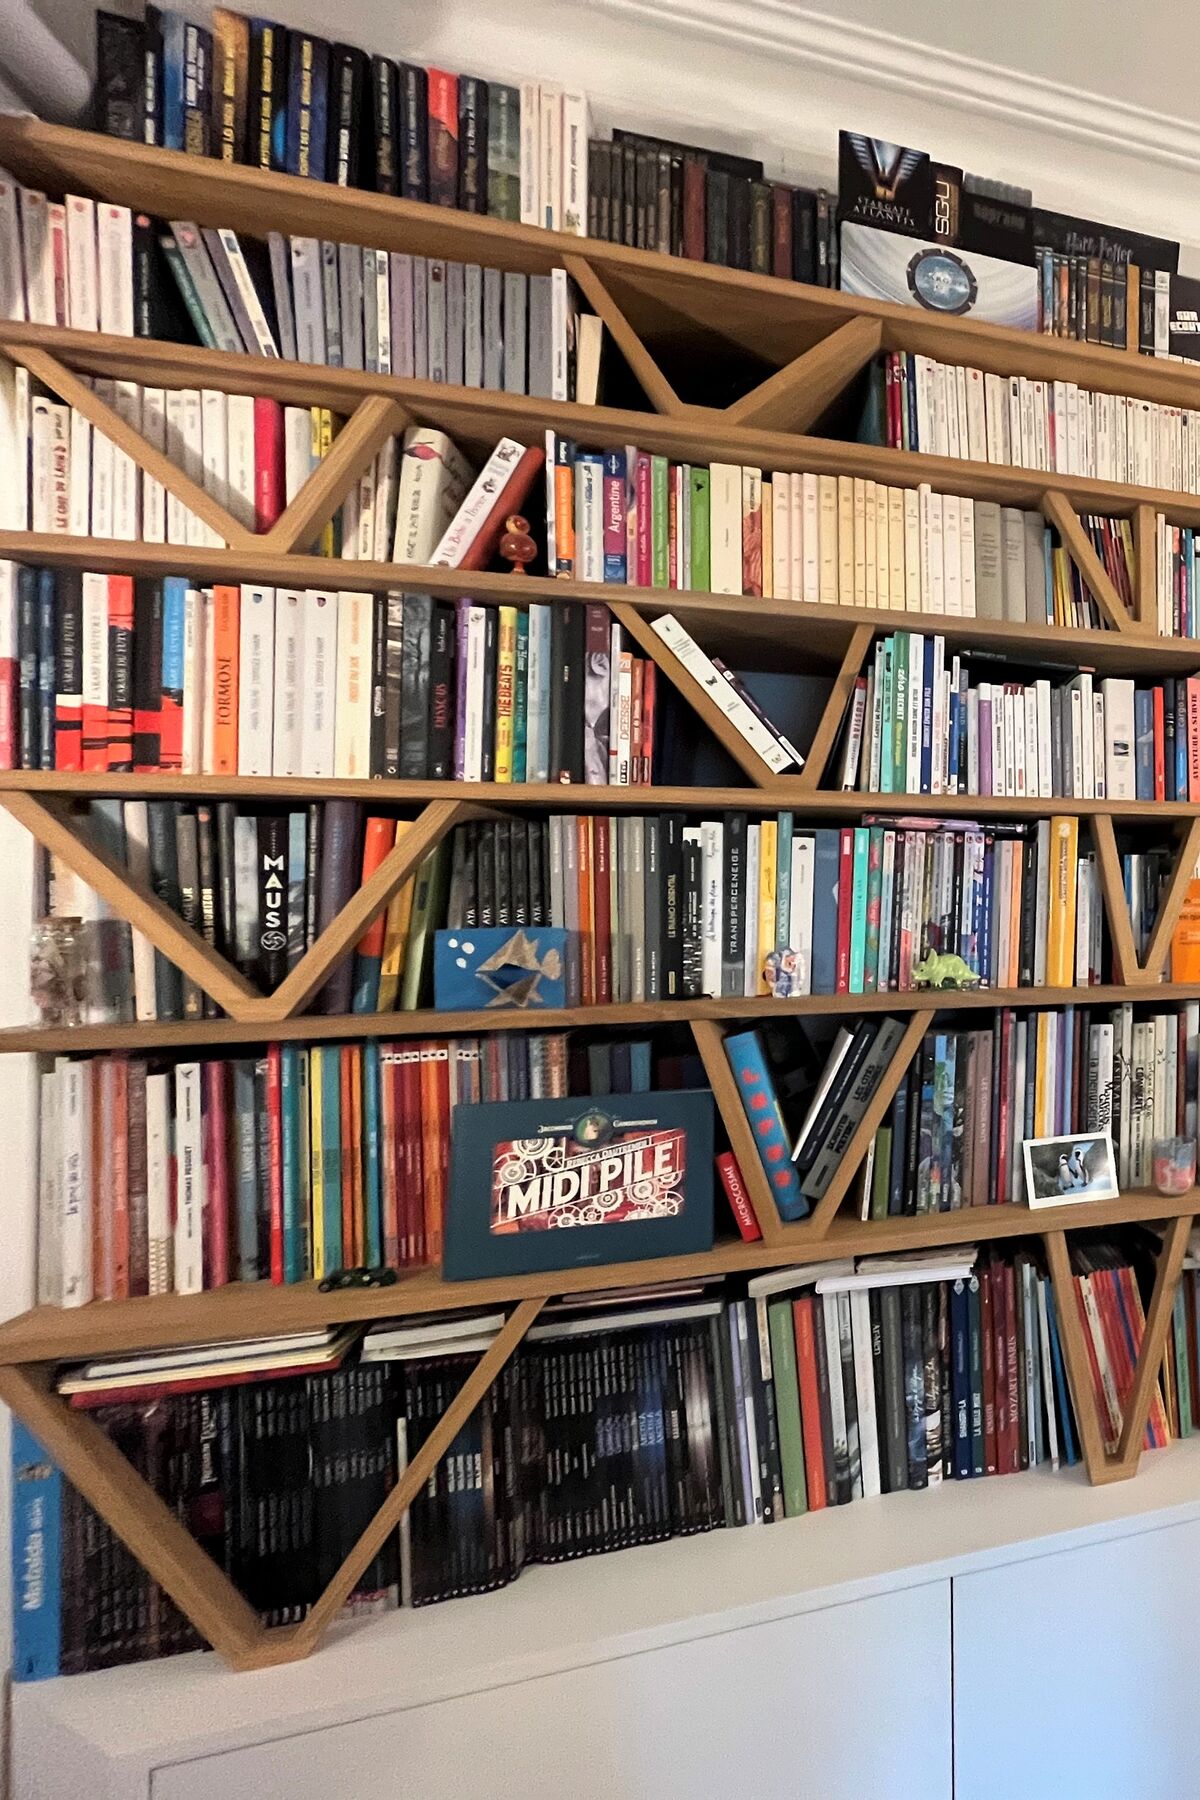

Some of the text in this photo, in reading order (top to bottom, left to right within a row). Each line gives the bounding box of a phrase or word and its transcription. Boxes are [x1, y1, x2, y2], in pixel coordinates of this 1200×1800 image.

[852, 203, 916, 227] ATLANTIS
[935, 180, 950, 235] SGU
[608, 480, 622, 533] Argentine
[216, 655, 232, 726] FORMOSE
[498, 664, 512, 718] THE BEATS
[1177, 702, 1186, 728] cargo
[1190, 693, 1199, 726] SURVIE
[1190, 734, 1199, 780] AVENTURE
[263, 855, 284, 928] MAUS
[466, 909, 475, 925] AYA
[482, 908, 491, 924] AYA
[499, 908, 508, 924] AYA
[516, 908, 524, 924] AYA
[730, 847, 739, 954] TRANSPERCENEIGE
[1113, 1060, 1121, 1118] TSUNAMI
[1135, 1067, 1144, 1110] COMMENT
[184, 1146, 193, 1206] THOMAS PESQUET
[507, 1142, 673, 1218] MIDI PILE
[724, 1165, 752, 1227] MICROCOSME
[1006, 1335, 1019, 1422] MOZART PARIS
[958, 1399, 968, 1438] SHANGRI-LA
